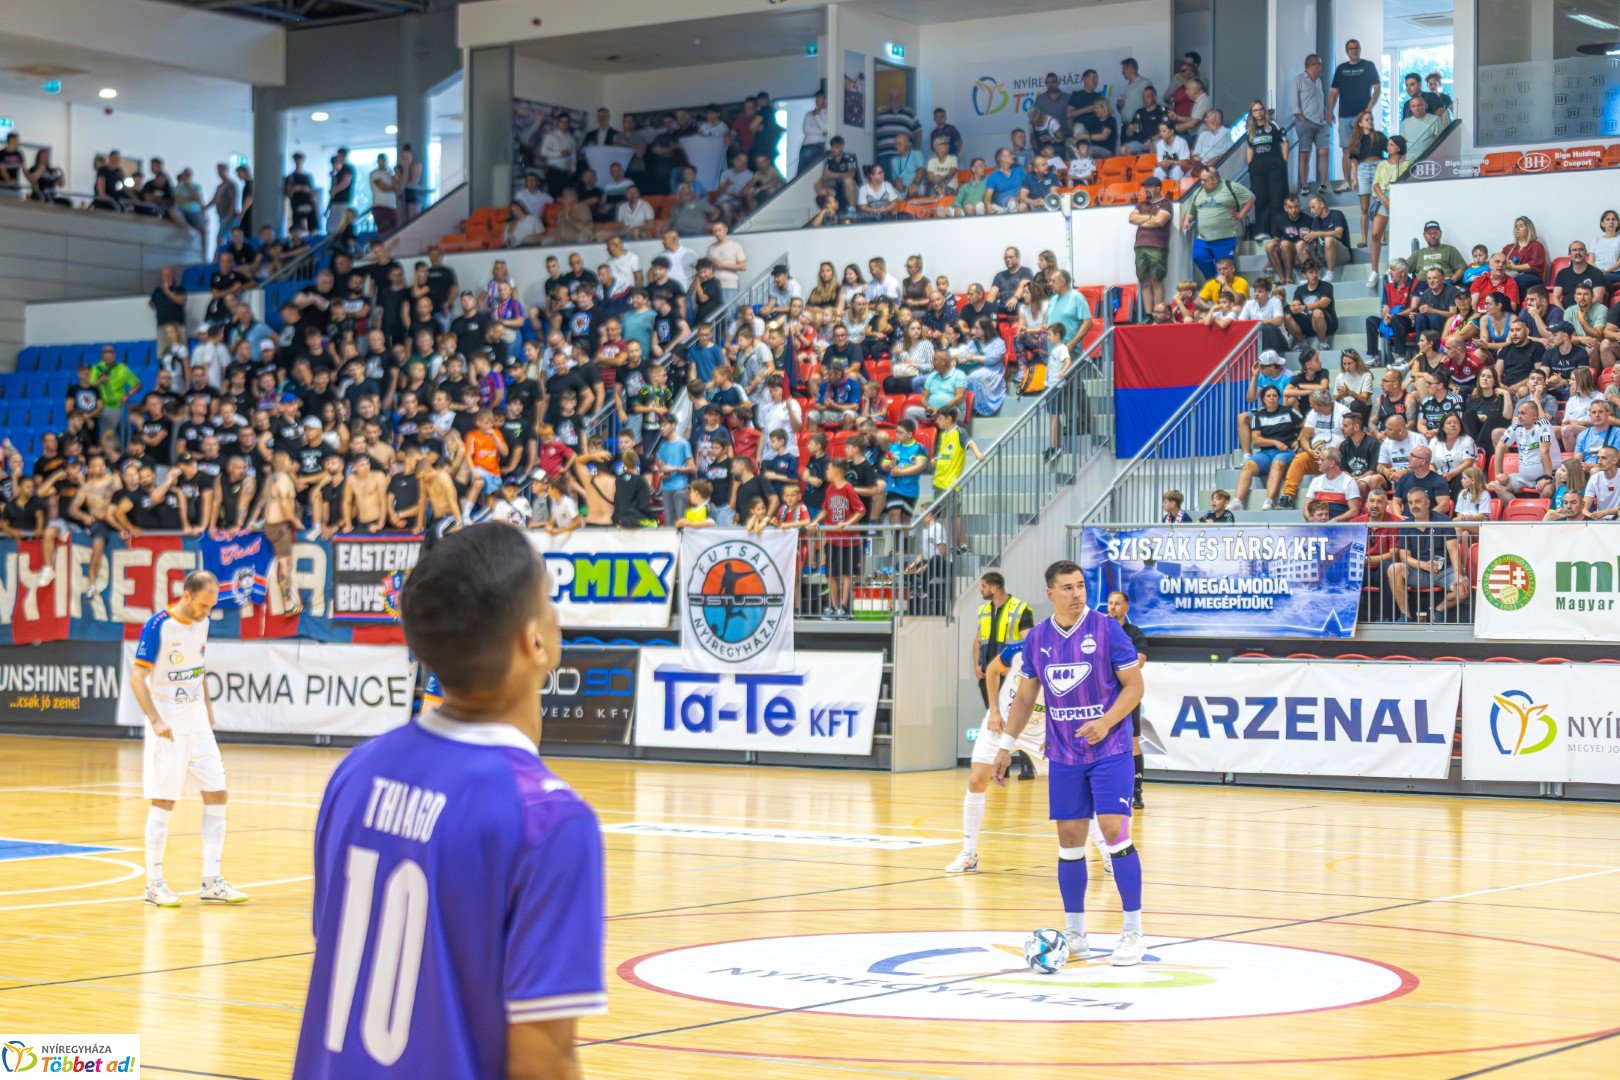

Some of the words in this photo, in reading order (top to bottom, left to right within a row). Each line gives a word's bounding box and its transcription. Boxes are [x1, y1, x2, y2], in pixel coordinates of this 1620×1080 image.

[1563, 159, 1592, 168] Csoport
[1573, 150, 1601, 159] Holding
[336, 542, 421, 572] EASTERN
[1108, 530, 1191, 562] SZISZÁK
[1195, 531, 1218, 561] ÉS
[1222, 530, 1288, 561] TÁRSA
[1293, 536, 1335, 562] KFT.
[698, 545, 770, 577] FUTSAL
[336, 584, 385, 612] BOYS
[1160, 576, 1182, 595] ÖN
[1185, 574, 1294, 596] MEGÁLMODJA,
[1175, 597, 1192, 609] MI
[1195, 594, 1274, 610] MEGÉPÍTJÜK!
[1556, 596, 1615, 611] Magyar
[583, 668, 633, 696] 90
[1053, 668, 1075, 680] MOL
[41, 694, 51, 711] jó
[53, 695, 80, 710] zene!
[305, 674, 408, 707] PINCE
[653, 665, 806, 737] Ta-Te
[810, 705, 862, 739] KFT
[597, 708, 630, 719] KFT
[1169, 695, 1446, 744] ARZENAL
[1567, 744, 1605, 753] MEGYEI
[363, 776, 447, 843] THIAGO
[324, 844, 429, 1066] 10
[707, 966, 1135, 1011] NYÍREGYHÁZA
